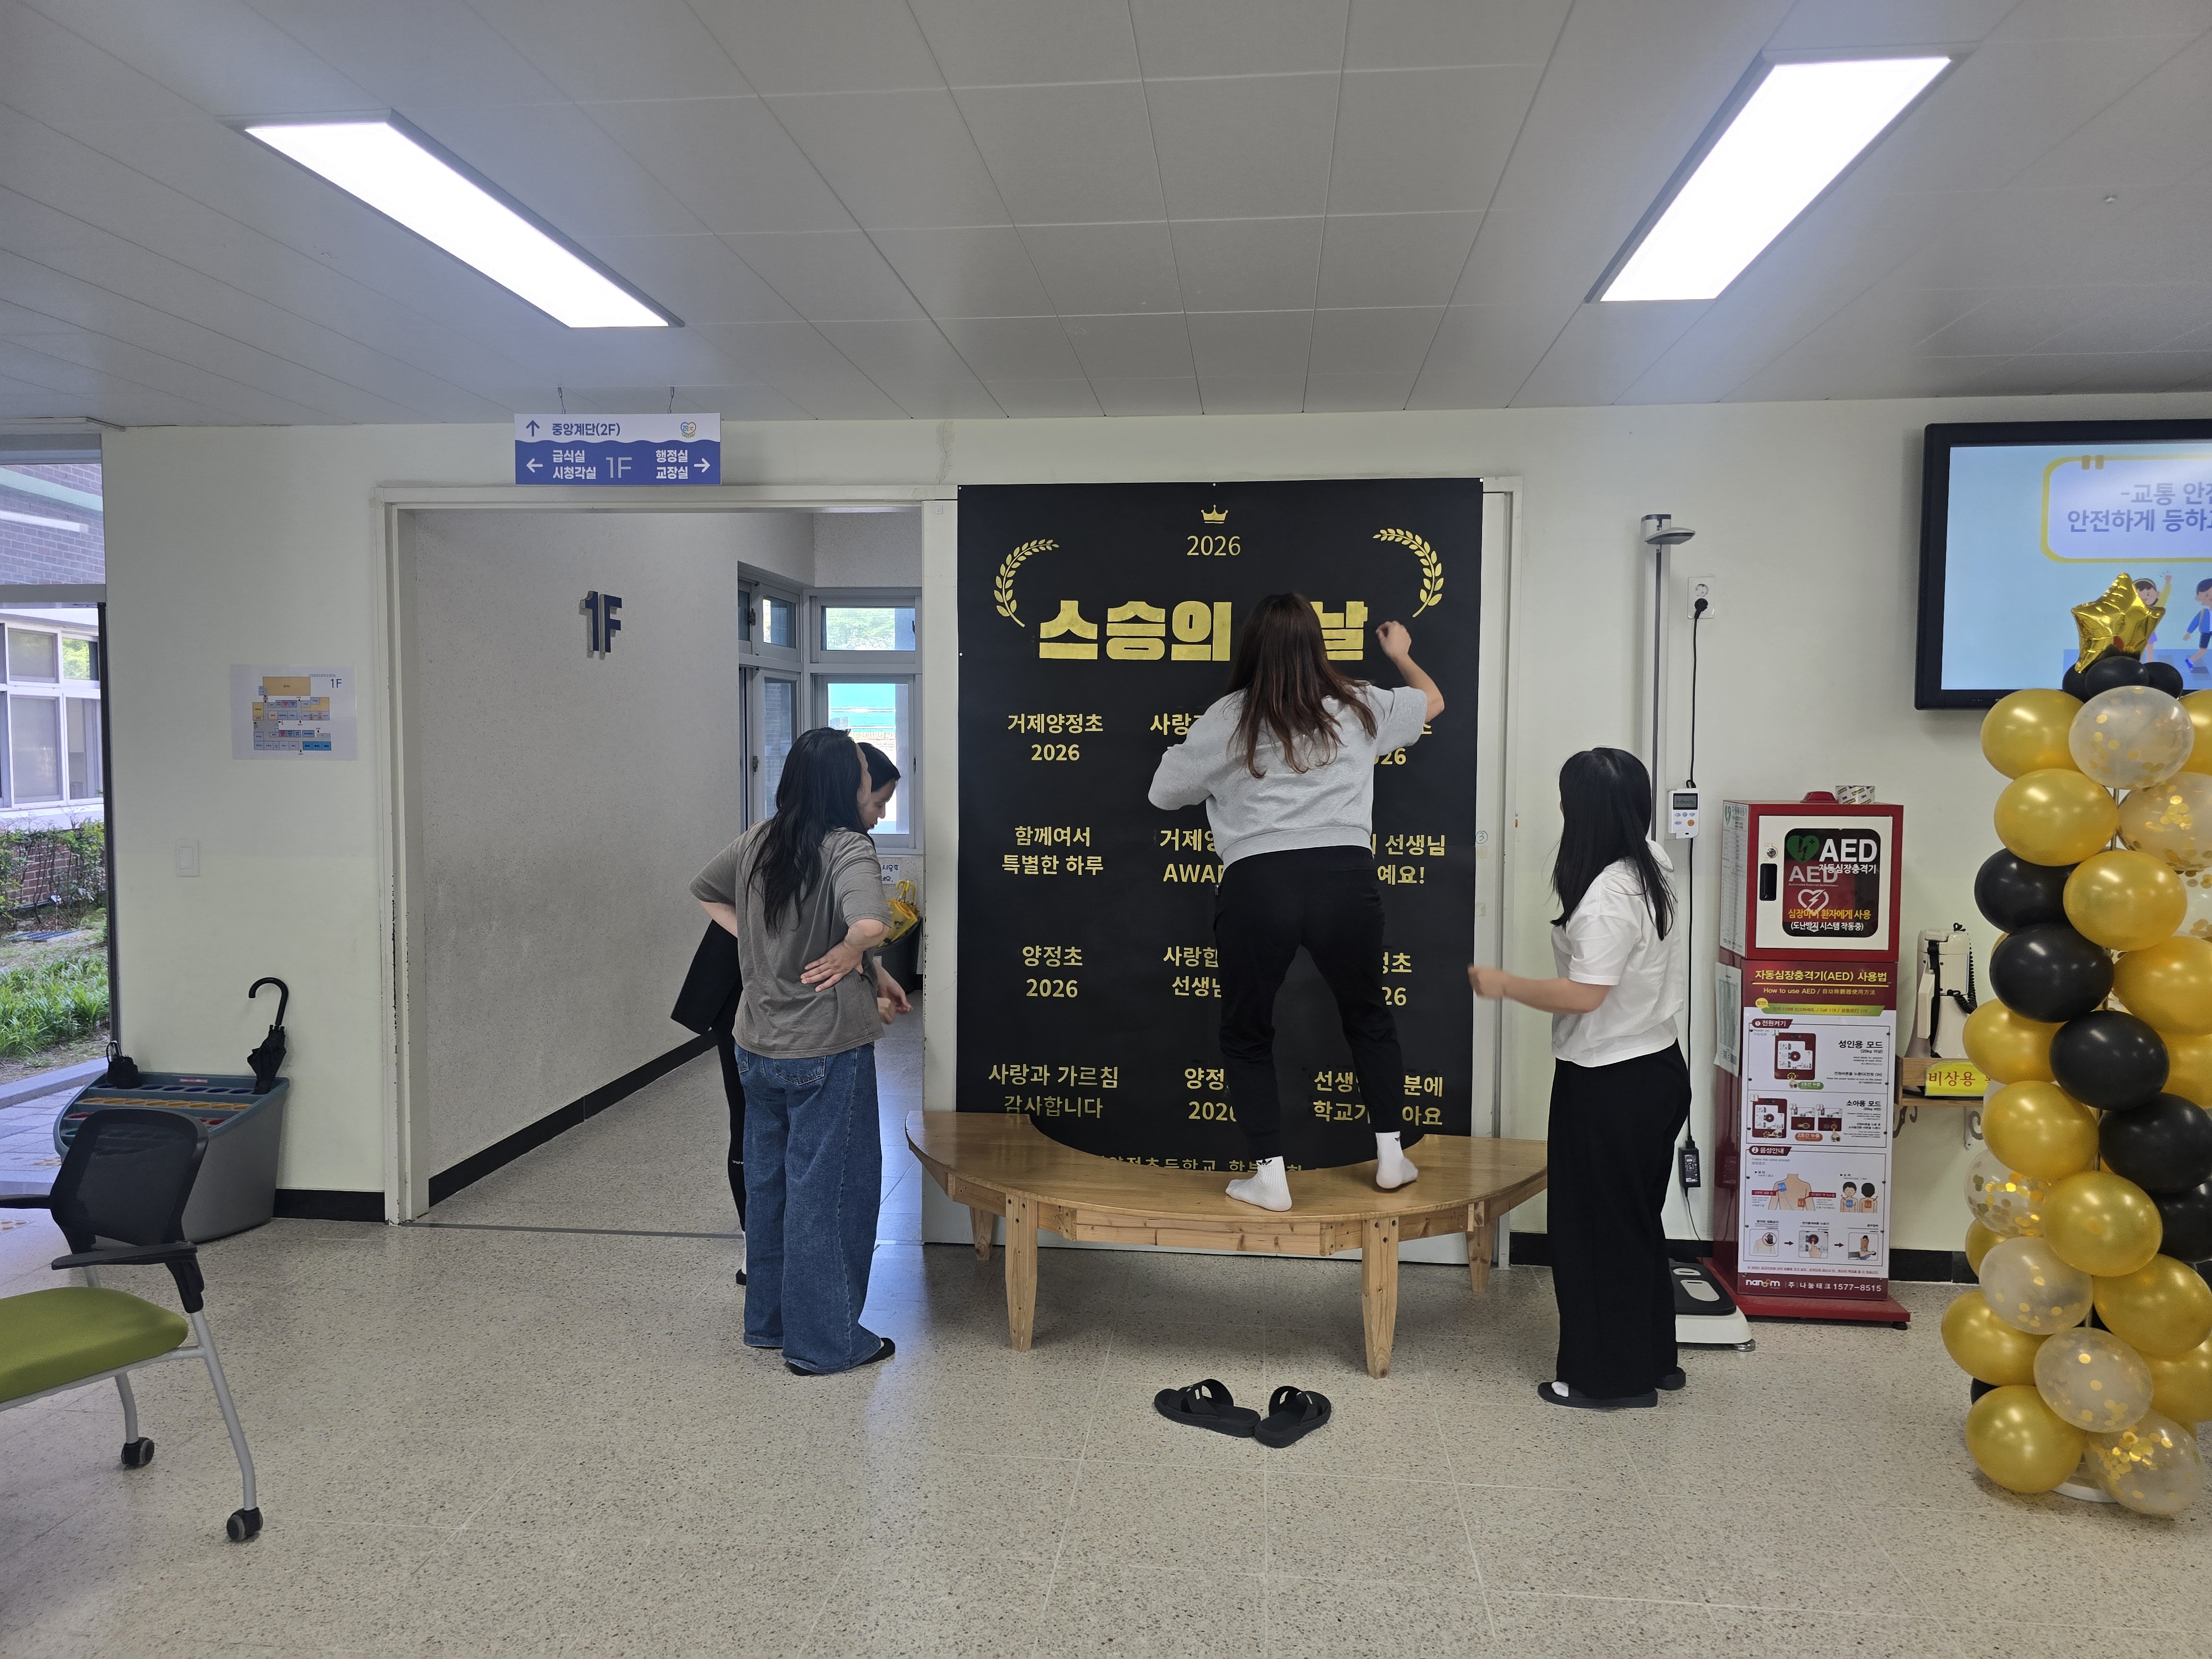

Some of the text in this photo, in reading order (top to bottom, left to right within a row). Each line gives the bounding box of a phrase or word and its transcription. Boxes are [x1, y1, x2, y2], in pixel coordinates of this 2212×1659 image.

[552, 422, 620, 437] 중앙계단(2F)
[552, 450, 585, 463] 급식실
[656, 450, 688, 463] 행정실
[552, 466, 596, 480] 시청각실
[606, 457, 632, 479] 1F
[656, 466, 688, 480] 교장실
[2067, 509, 2155, 533] 안전하게
[1187, 535, 1241, 556] 2026
[581, 591, 622, 653] 1F
[1039, 600, 1368, 661] 스승의 날
[330, 679, 342, 688] 1F
[1008, 713, 1103, 734] 거제양정초
[1150, 713, 1203, 735] 사랑
[1031, 744, 1080, 761] 2026
[1374, 748, 1406, 765] 26
[1015, 826, 1091, 847] 함께여서
[1385, 834, 1445, 856] 선생님
[1819, 838, 1877, 863] AED
[1001, 854, 1104, 875] 특별한 하루
[1377, 864, 1425, 885] 예요!
[1788, 865, 1838, 883] AED
[1818, 864, 1877, 874] 자동심장충격기
[1821, 909, 1853, 920] 환자에게
[1854, 910, 1871, 920] 사용
[1820, 922, 1840, 930] 시스템
[1841, 922, 1864, 931] 작동중)
[1022, 945, 1083, 967] 양정초
[1163, 946, 1219, 968] 사랑합
[1383, 952, 1412, 974] 초
[1755, 970, 1887, 982] 자동심장충격기(AED) 사용법
[1026, 978, 1078, 998] 2026
[1381, 987, 1406, 1006] 26
[1838, 1040, 1863, 1048] 성인용
[989, 1063, 1118, 1088] 사랑과 가르침
[1185, 1067, 1224, 1091] 양정
[1314, 1071, 1443, 1097] 선생 분에
[1928, 1071, 1976, 1087] 비상용
[1004, 1094, 1103, 1119] 감사합니다
[1402, 1105, 1443, 1126] 아요
[1833, 1284, 1882, 1292] 1577-8515
